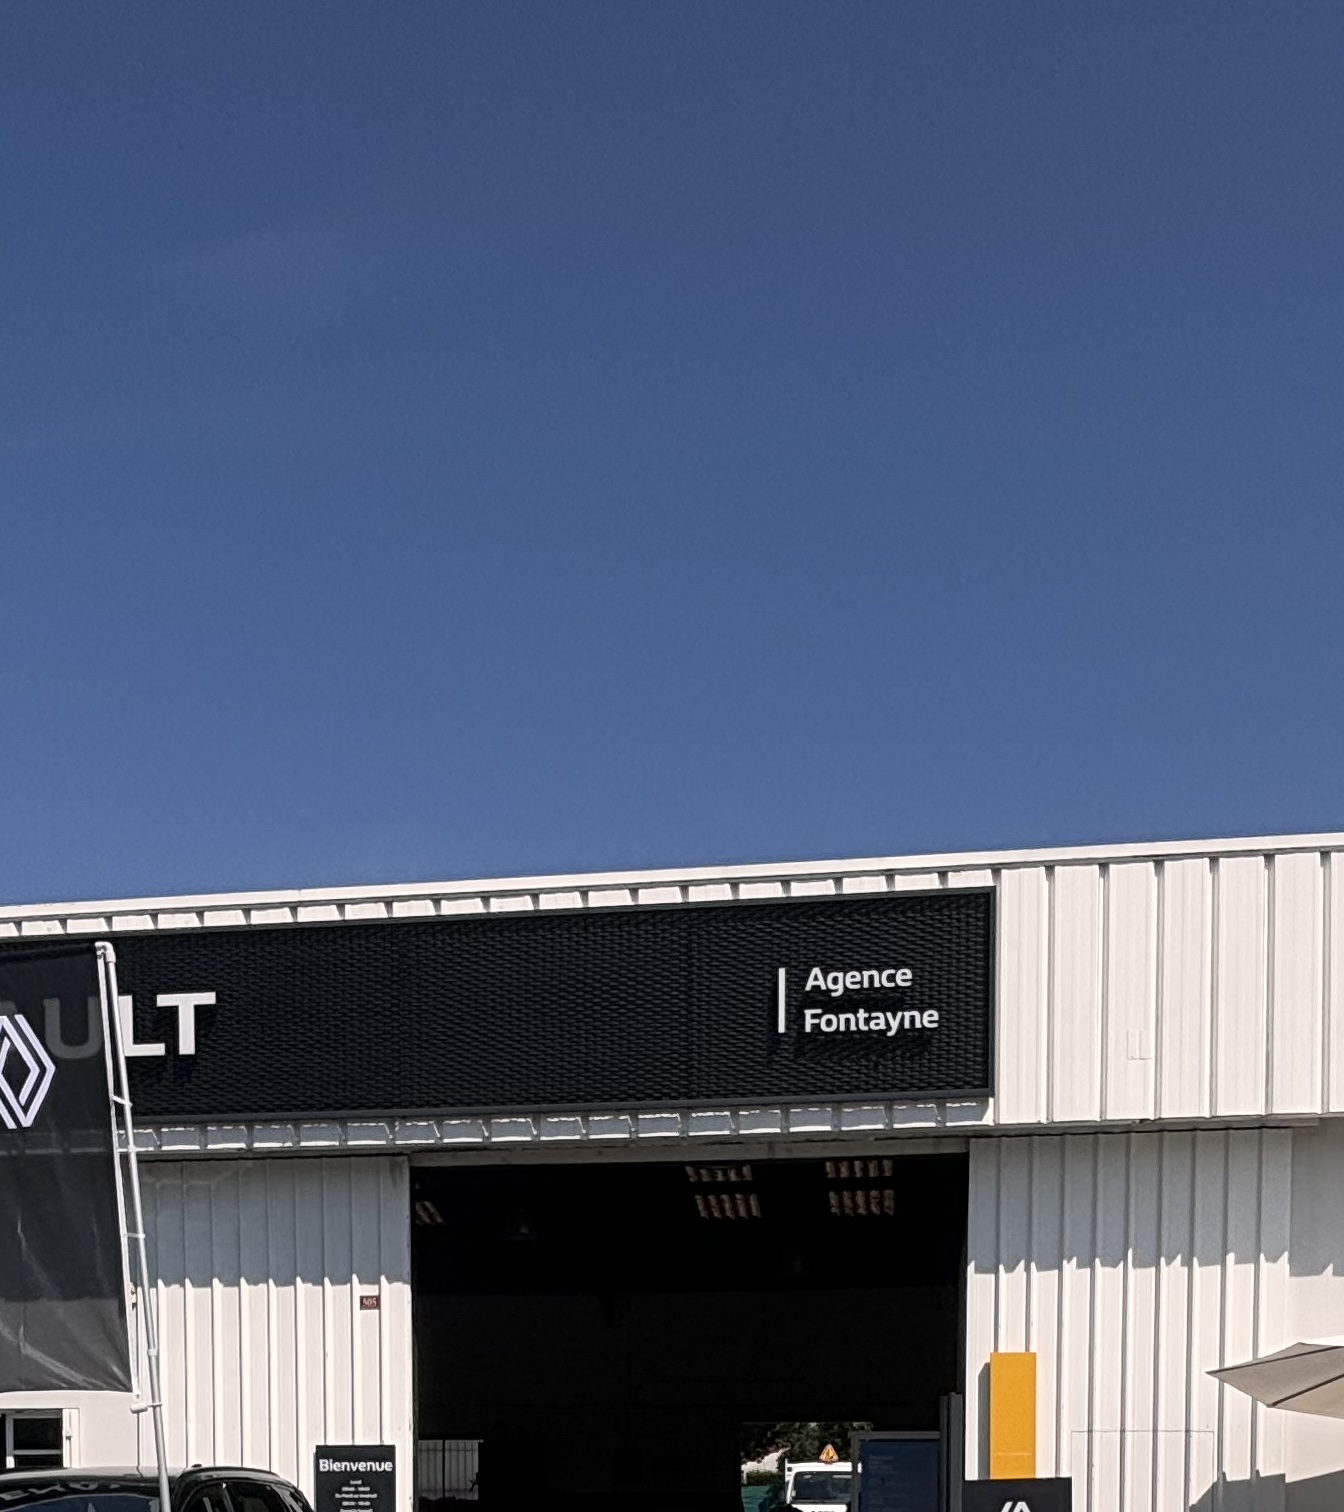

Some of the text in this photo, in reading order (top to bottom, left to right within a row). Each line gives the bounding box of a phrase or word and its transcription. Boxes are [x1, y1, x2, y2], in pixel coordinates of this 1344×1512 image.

[805, 966, 913, 997] Agence
[804, 1008, 939, 1037] Fontayne
[318, 1458, 394, 1472] Bienvenue
